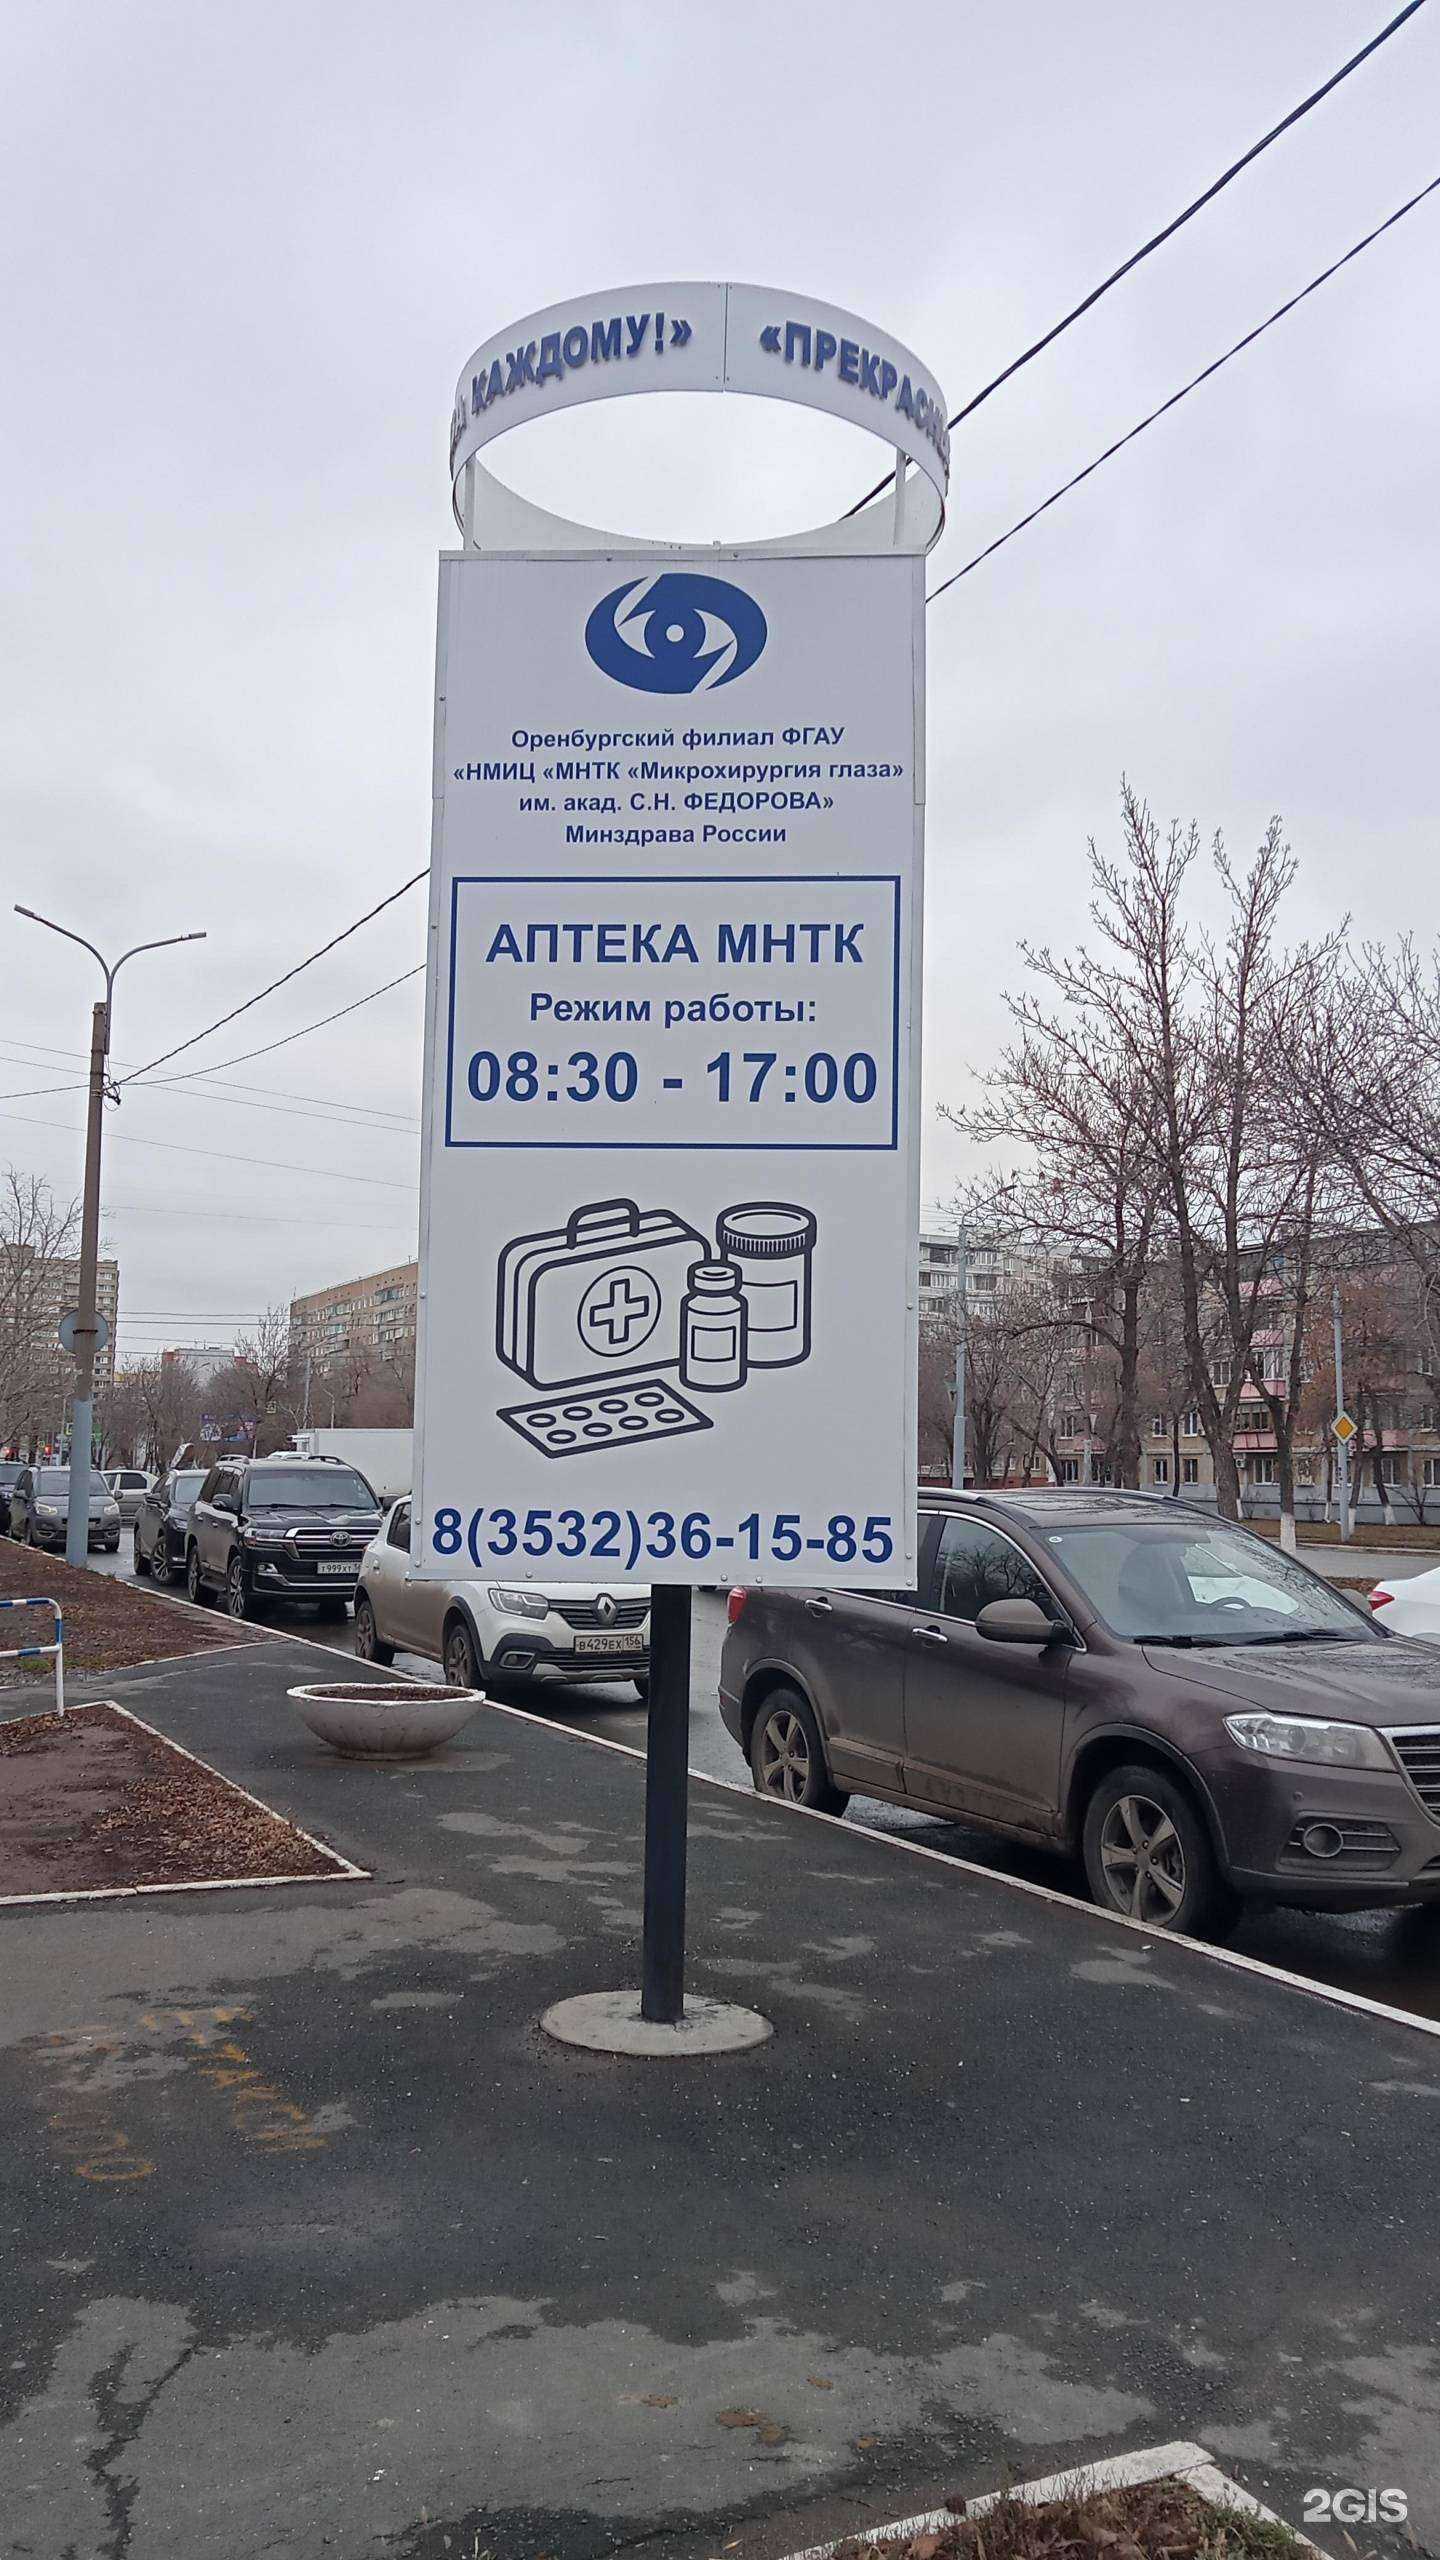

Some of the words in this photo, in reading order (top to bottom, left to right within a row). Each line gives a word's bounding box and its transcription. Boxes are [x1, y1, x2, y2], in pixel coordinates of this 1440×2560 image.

[471, 312, 693, 416] КАЖДОМУ!»
[512, 729, 675, 753] Оренбургский
[682, 727, 774, 751] филиал
[781, 726, 845, 745] ФГАУ
[454, 761, 535, 783] «НМИЦ
[542, 761, 620, 780] «МНТК
[628, 760, 821, 784] «Микрохирургия
[829, 760, 904, 778] глаза»
[519, 797, 556, 812] им.
[564, 797, 622, 814] акад.
[630, 792, 676, 811] С.Н.
[683, 791, 834, 814] ФЕДОРОВА»
[566, 825, 695, 848] Минздрава
[702, 824, 786, 843] России
[485, 923, 700, 963] АПТЕКА
[717, 923, 865, 963] МНТК
[530, 992, 651, 1022] Режим
[664, 992, 816, 1029] работы:
[467, 1051, 638, 1103] 08:30
[706, 1051, 877, 1104] 17:00
[432, 1507, 894, 1571] 8(3532)36-15-85
